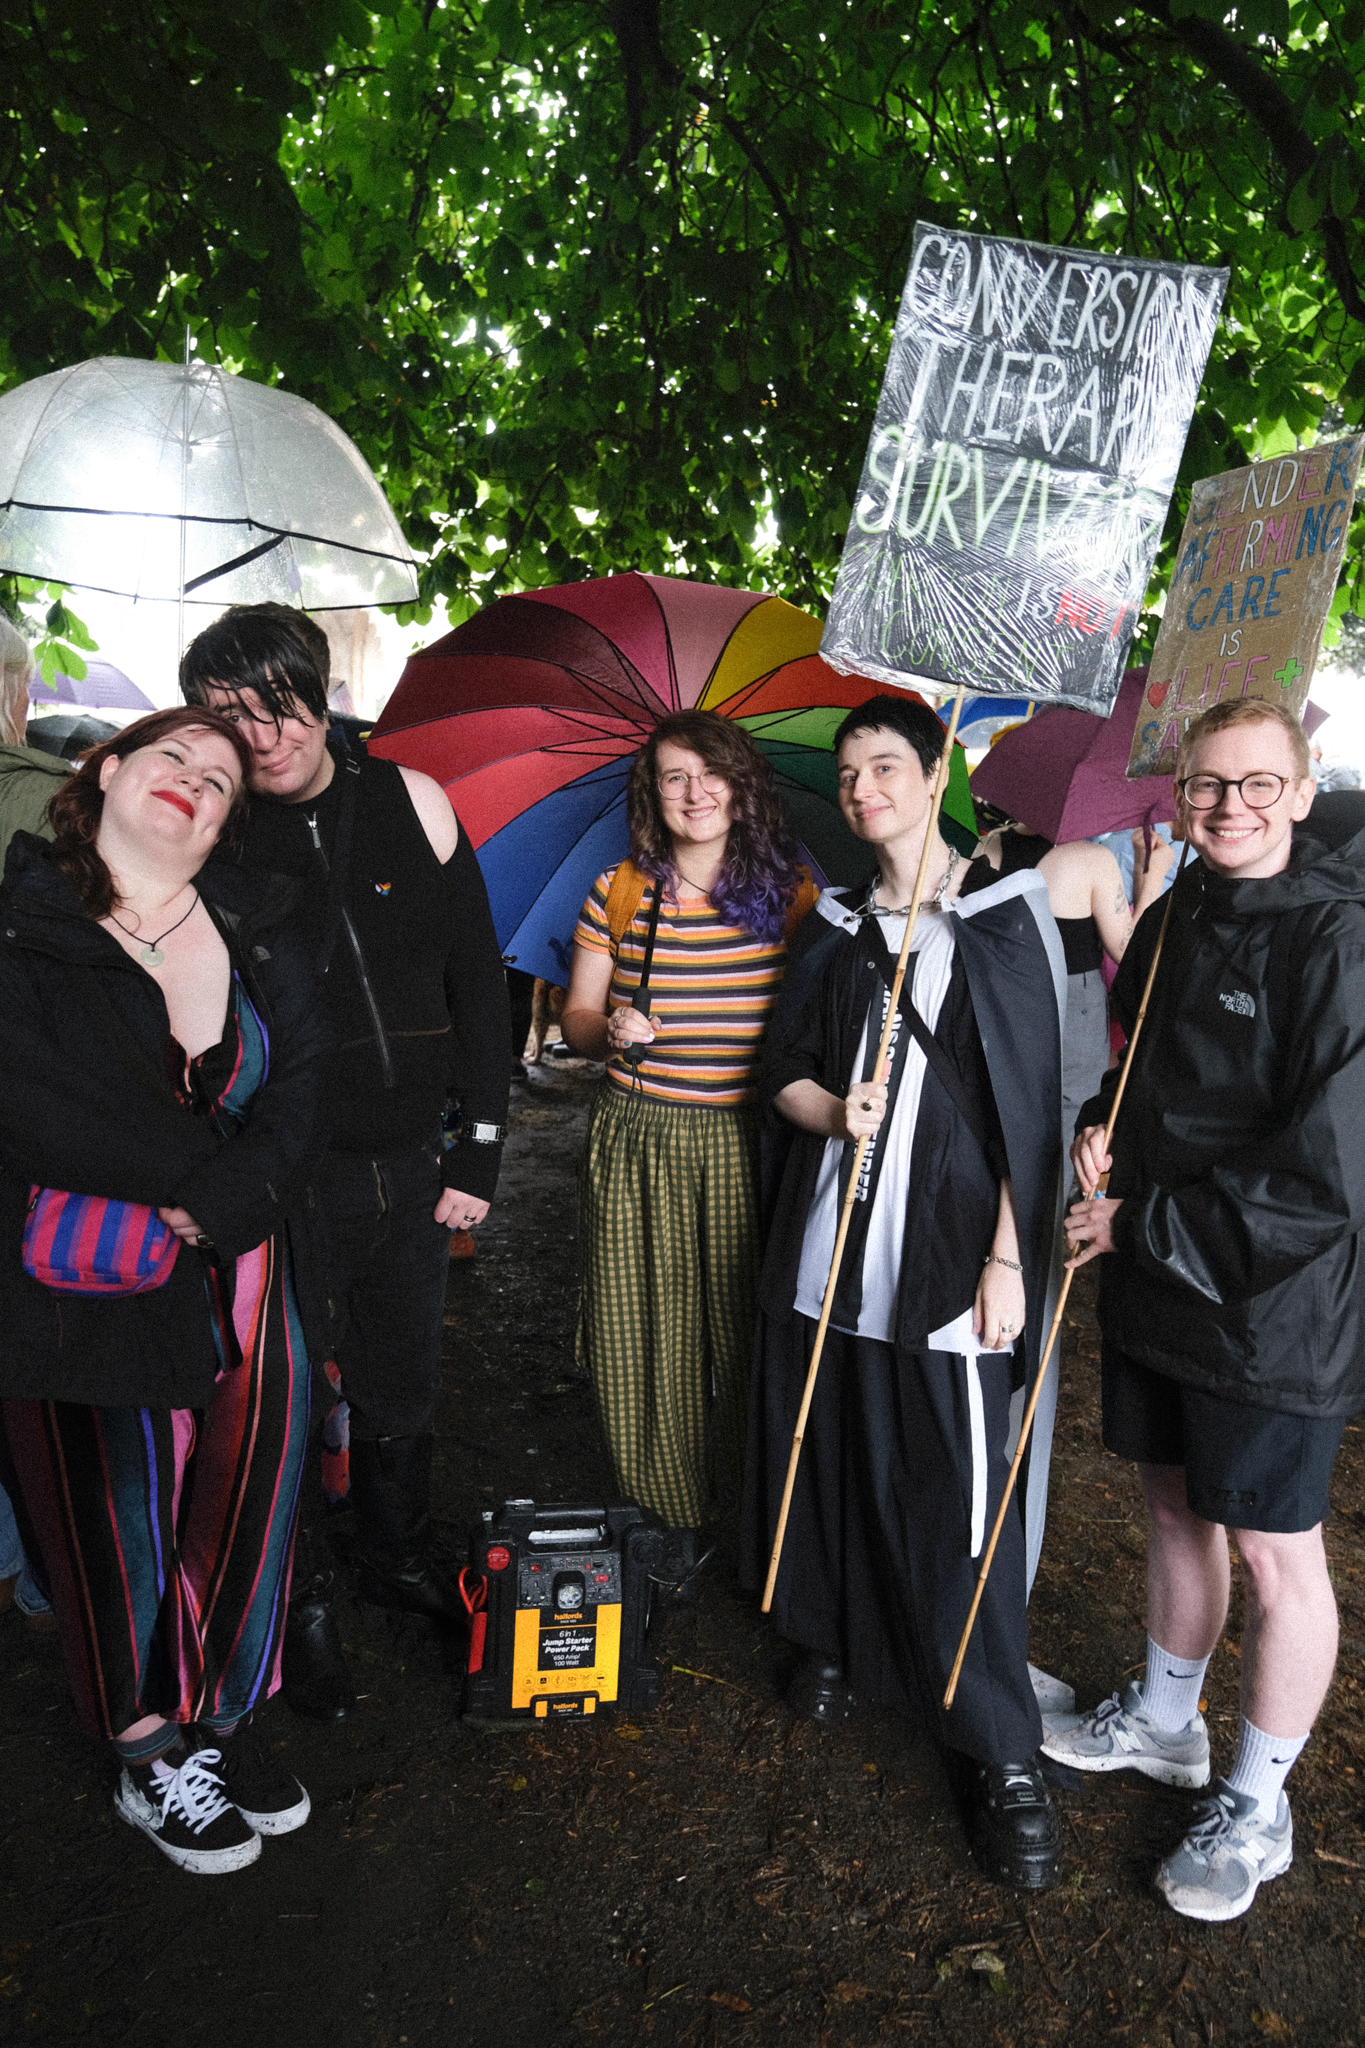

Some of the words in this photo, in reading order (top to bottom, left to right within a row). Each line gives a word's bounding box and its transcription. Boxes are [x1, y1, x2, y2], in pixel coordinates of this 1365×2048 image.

[901, 328, 1168, 467] THERAP
[1193, 442, 1355, 525] GENDER
[1173, 500, 1347, 588] AFFIRMING
[1016, 578, 1060, 620] IS
[1055, 586, 1138, 640] NOT
[1187, 569, 1291, 631] CARE
[1219, 629, 1243, 657] IS
[1174, 655, 1269, 711] LIFE
[1219, 993, 1246, 1008] NORTH
[1224, 1001, 1244, 1014] FACE
[1233, 990, 1248, 1000] THE
[554, 1612, 582, 1620] halfords
[559, 1630, 564, 1638] 6
[570, 1644, 590, 1652] Pack
